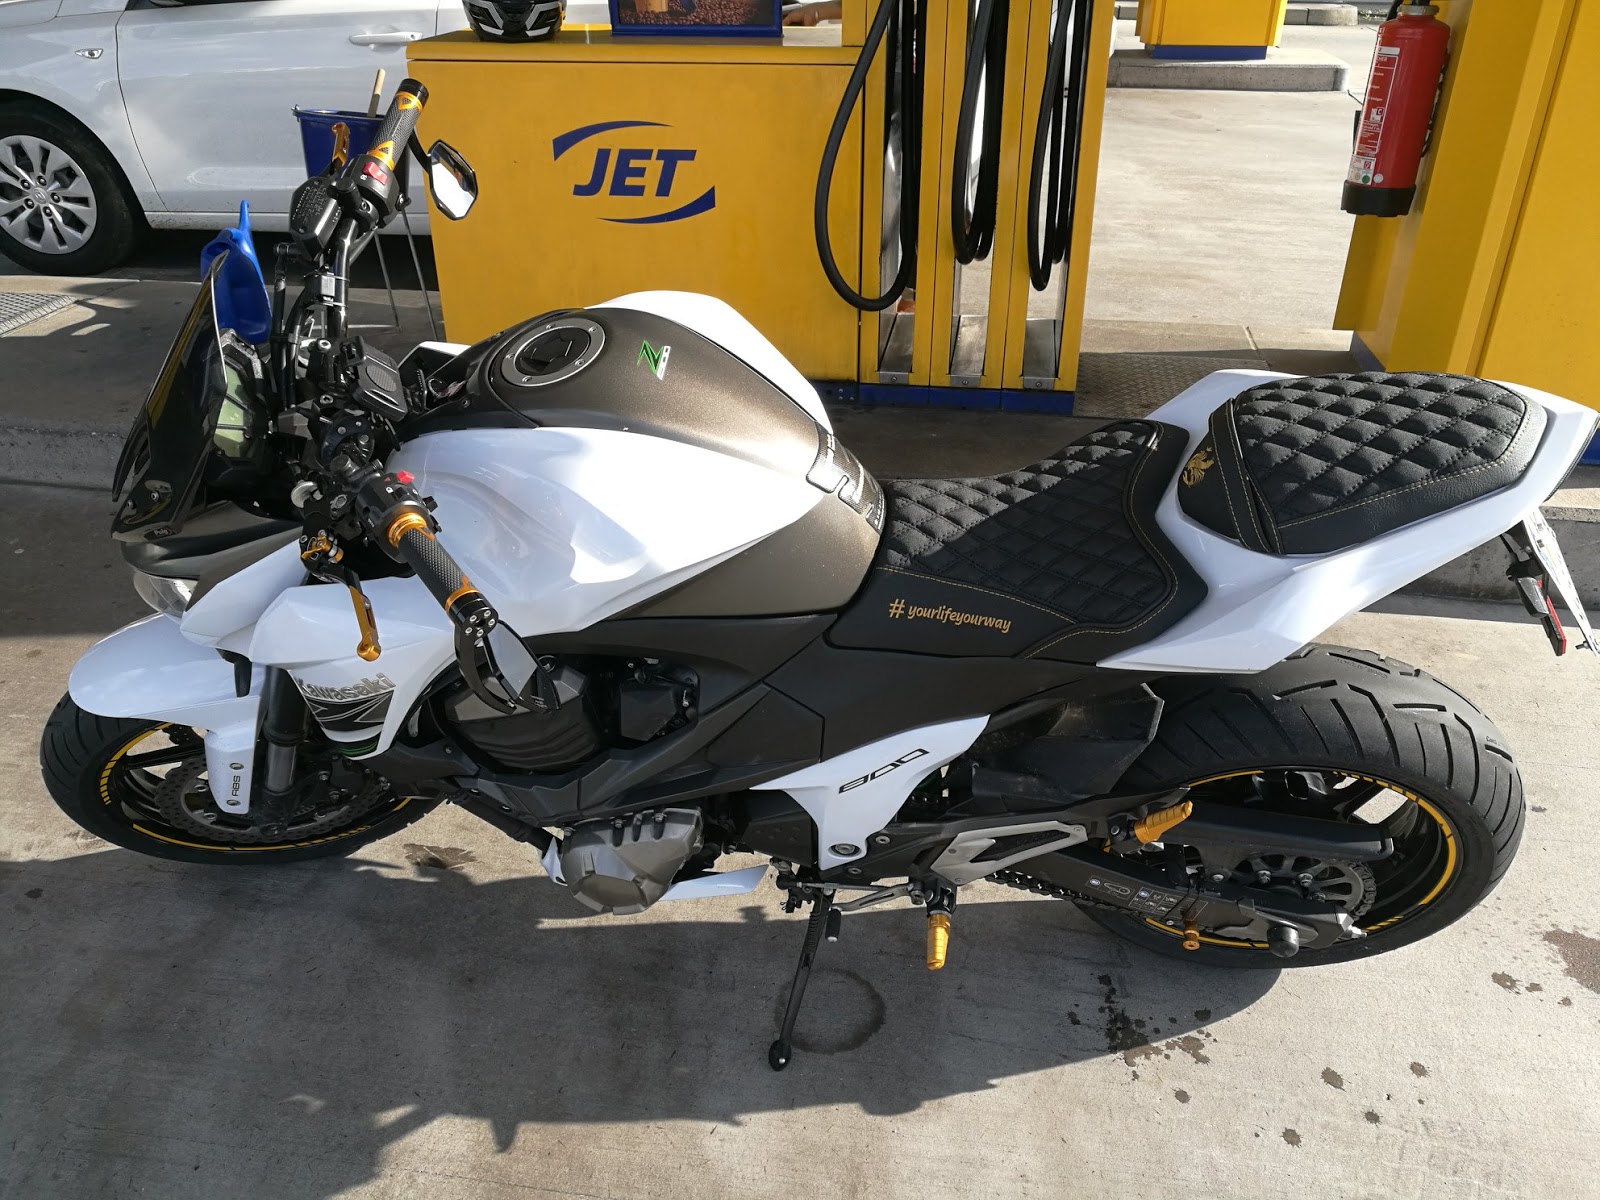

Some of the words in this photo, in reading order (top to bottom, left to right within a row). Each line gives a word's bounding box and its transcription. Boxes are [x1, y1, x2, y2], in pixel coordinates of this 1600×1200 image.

[572, 148, 697, 197] JET
[231, 775, 241, 797] ABS
[838, 748, 930, 794] 800
